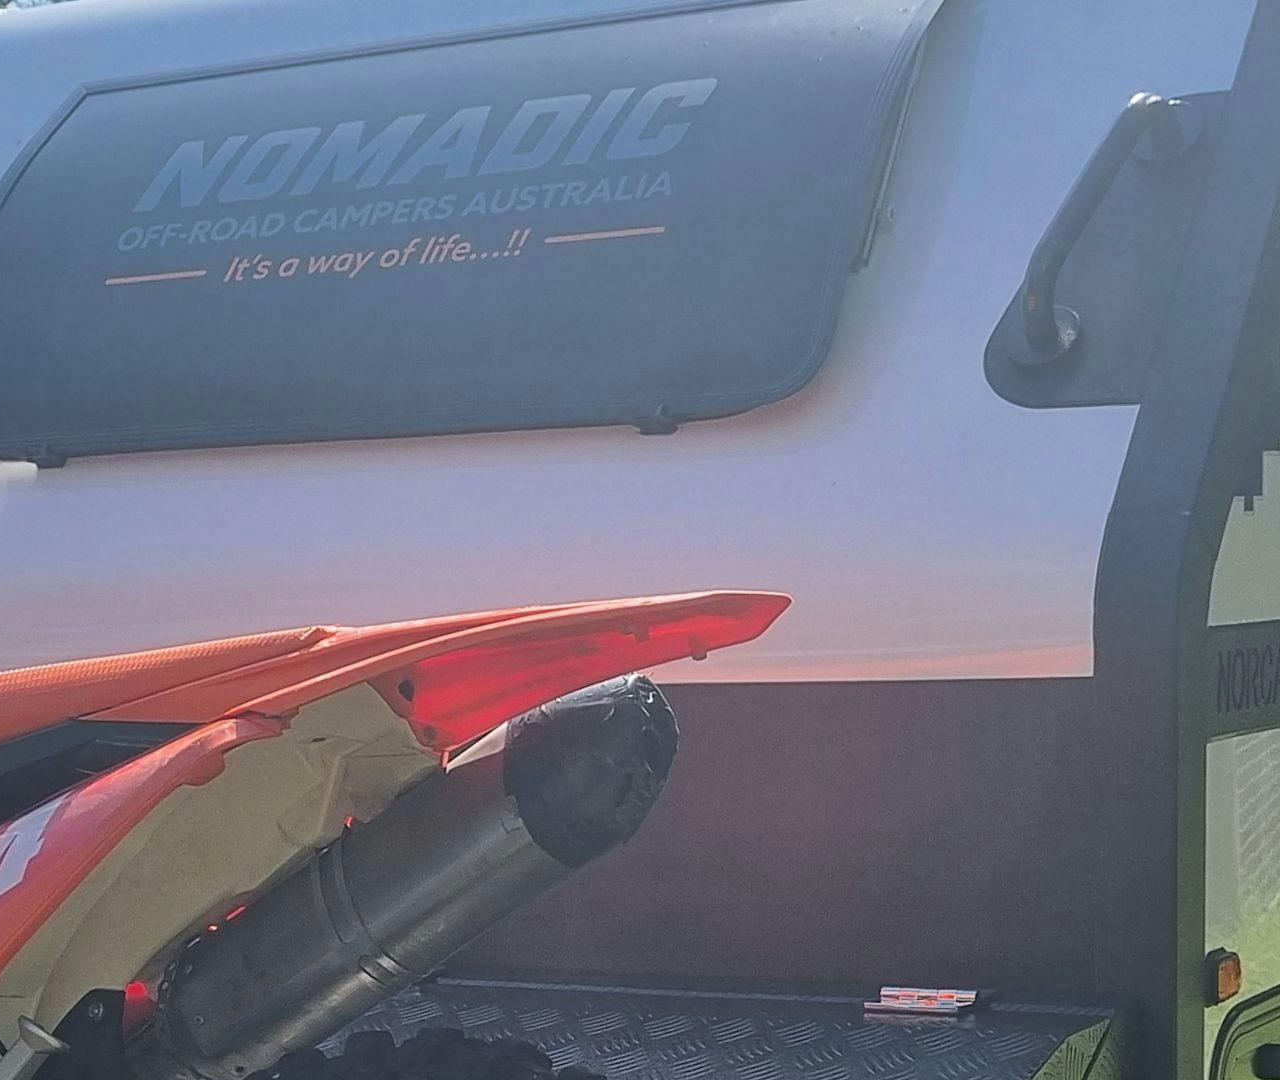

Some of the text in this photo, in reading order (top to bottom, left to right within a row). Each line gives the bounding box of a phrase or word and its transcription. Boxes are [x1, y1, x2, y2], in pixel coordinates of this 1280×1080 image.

[132, 77, 718, 213] NOMADIC
[117, 171, 673, 252] OFF-ROAD CAMPERS AUSTRALIA
[223, 253, 273, 283] It's
[278, 257, 301, 279] a
[307, 250, 376, 279] way
[379, 237, 421, 268] of
